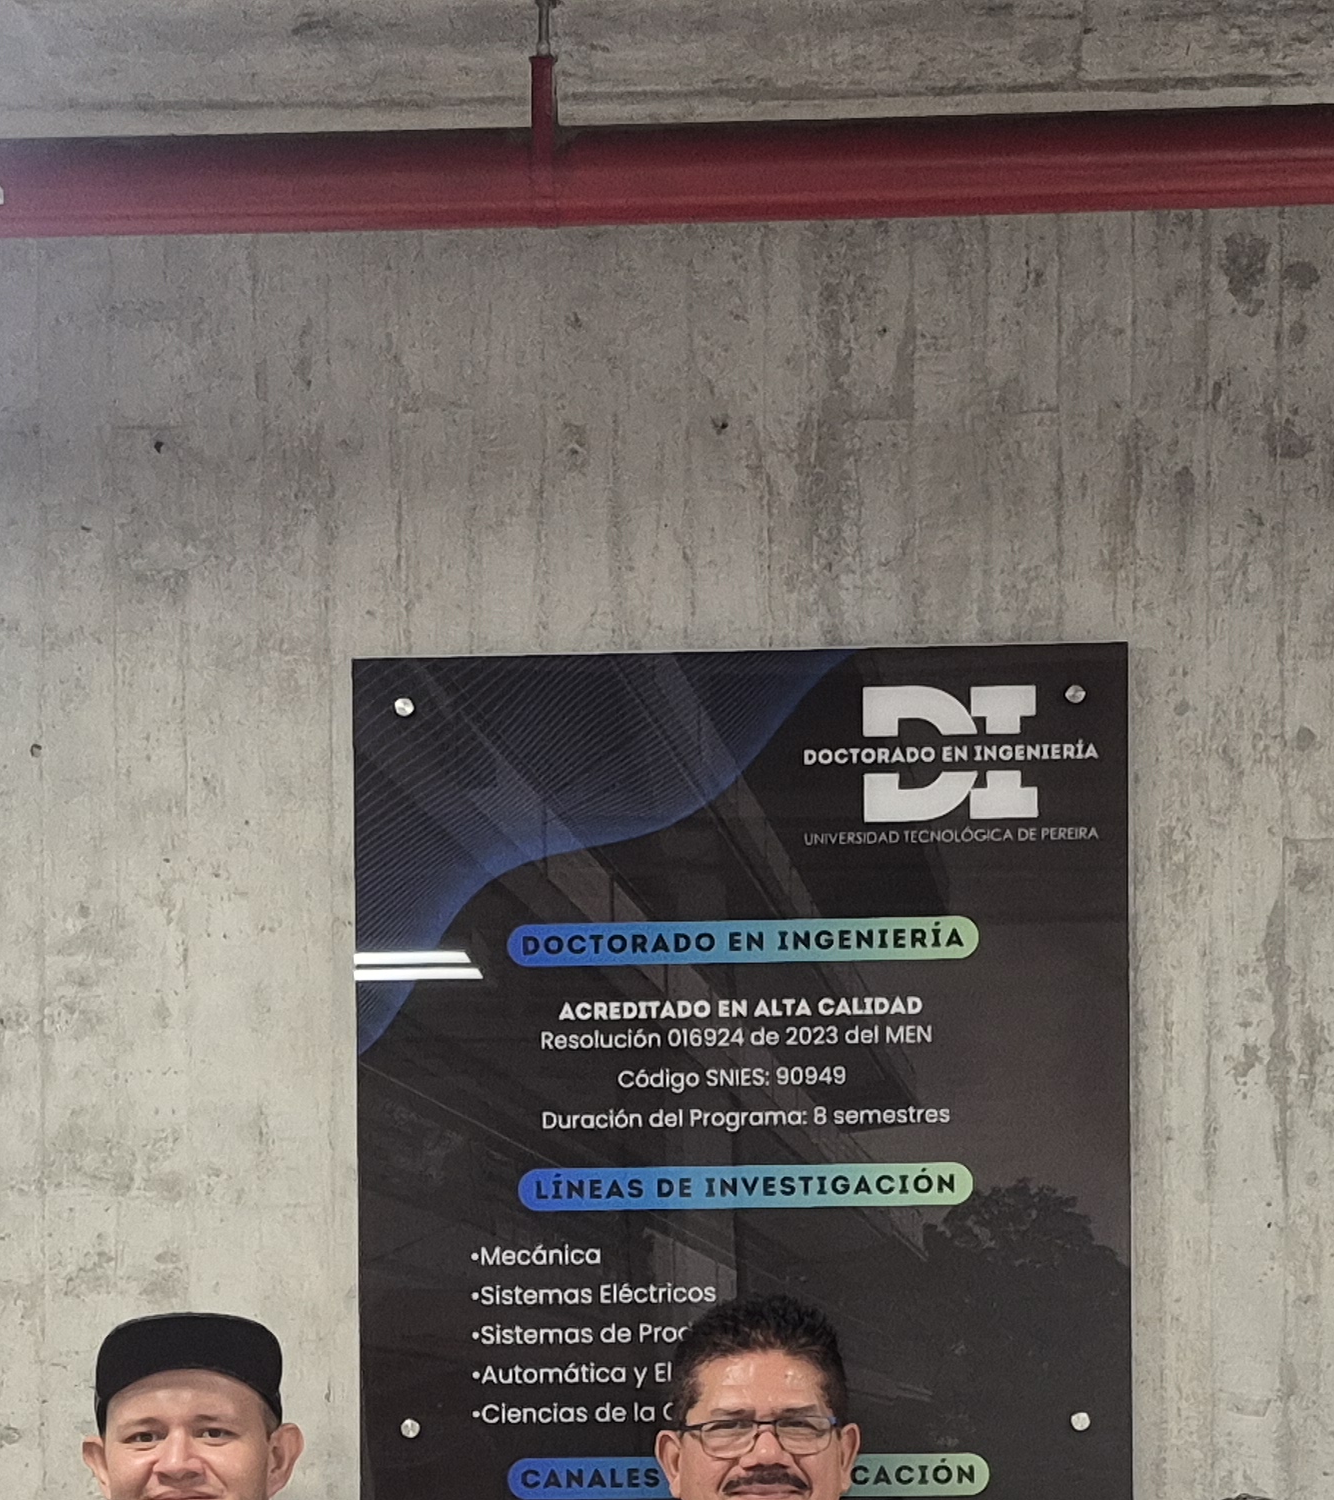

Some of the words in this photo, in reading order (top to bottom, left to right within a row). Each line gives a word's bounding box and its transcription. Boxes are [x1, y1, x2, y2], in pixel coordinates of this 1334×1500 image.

[803, 746, 936, 765] DOCTORADO
[942, 745, 968, 763] EN
[974, 739, 1099, 761] INGENIERÍA
[804, 830, 900, 846] UNIVERSIDAD
[904, 825, 1014, 843] TECNOLÓGICA
[1017, 827, 1037, 842] DE
[1041, 826, 1099, 840] PEREIRA
[522, 932, 716, 956] DOCTORADO
[728, 931, 764, 952] EN
[777, 922, 964, 952] INGENIERÍA
[558, 999, 711, 1021] ACREDITADO
[718, 999, 748, 1018] EN
[753, 998, 812, 1018] ALTA
[818, 996, 923, 1016] CALIDAD
[541, 1028, 661, 1050] Resolución
[667, 1027, 745, 1047] 016924
[750, 1026, 780, 1046] de
[785, 1025, 839, 1045] 2023
[844, 1024, 879, 1044] del
[885, 1025, 932, 1044] MEN
[617, 1068, 700, 1094] Código
[705, 1067, 770, 1087] SNIES:
[776, 1066, 846, 1085] 90949
[542, 1108, 643, 1129] Duración
[648, 1108, 683, 1128] del
[689, 1108, 808, 1132] Programa:
[813, 1106, 827, 1125] 8
[833, 1106, 951, 1125] semestres
[535, 1172, 644, 1200] LÍNEAS
[656, 1177, 692, 1198] DE
[703, 1168, 955, 1199] INVESTIGACIÓN
[480, 1243, 601, 1266] Mecánica
[481, 1284, 593, 1305] Sistemas
[600, 1282, 717, 1304] Eléctricos
[481, 1323, 594, 1345] Sistemas
[600, 1322, 632, 1343] de
[481, 1362, 626, 1384] Automática
[633, 1366, 648, 1389] y
[481, 1402, 588, 1424] Ciencias
[595, 1402, 627, 1422] de
[634, 1402, 655, 1422] la
[520, 1467, 660, 1489] CANALES
